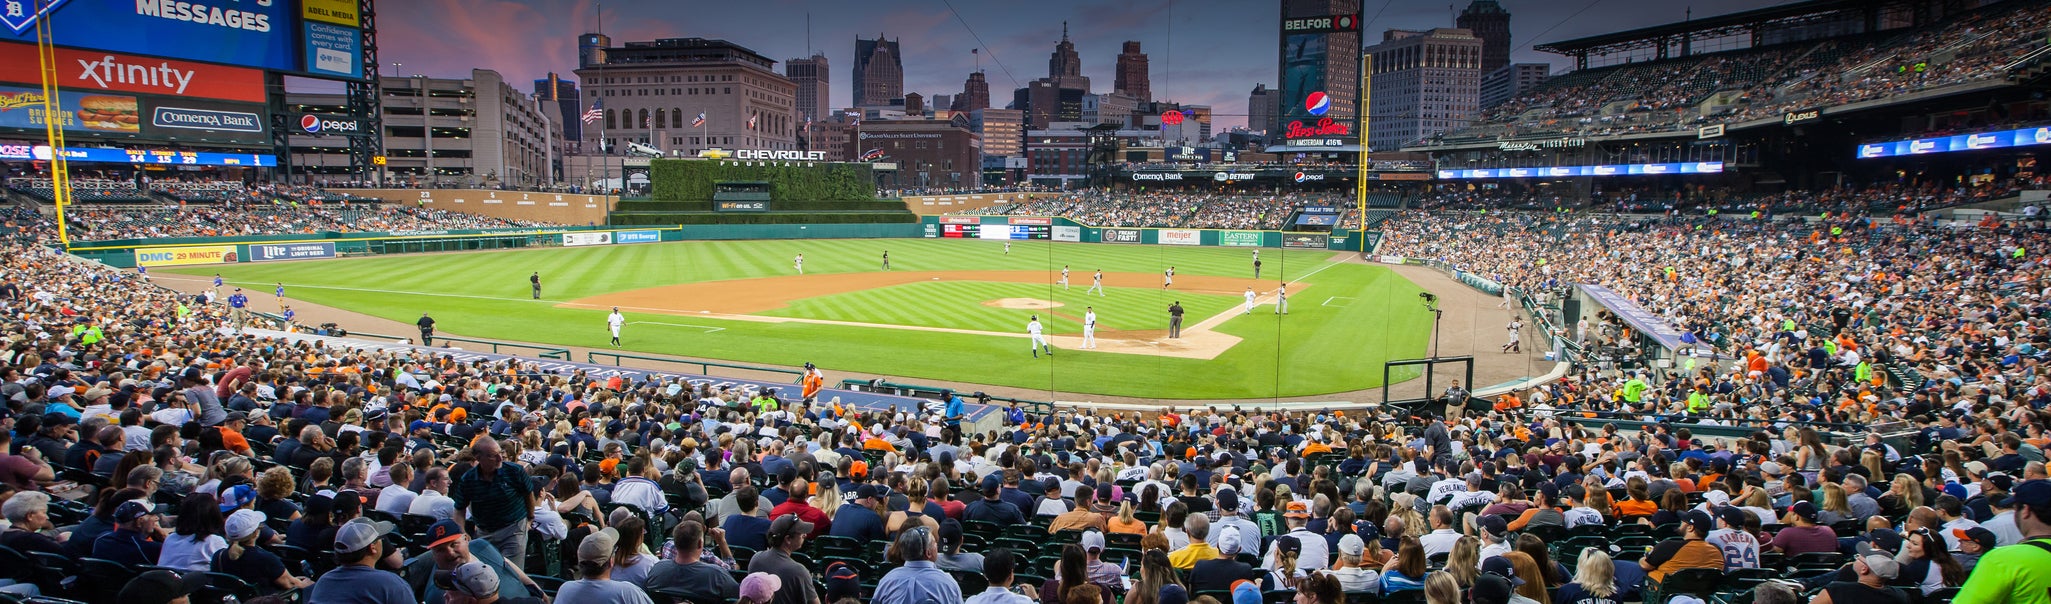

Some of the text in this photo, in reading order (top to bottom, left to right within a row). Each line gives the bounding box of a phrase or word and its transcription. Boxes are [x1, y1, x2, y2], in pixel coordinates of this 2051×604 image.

[137, 0, 271, 32] MESSAGES
[308, 6, 354, 20] ADELL MEDIA
[311, 24, 352, 36] Confidence
[1285, 18, 1331, 31] BELFOR
[311, 32, 353, 44] comes with
[312, 40, 333, 48] every
[78, 56, 195, 94] xfinity
[223, 115, 254, 126] Bank
[1793, 110, 1818, 121] LEXUS
[321, 120, 357, 132] pepsi
[737, 149, 826, 160] CHEVROLET
[1165, 172, 1183, 180] Bank
[1167, 231, 1192, 240] meijer
[1224, 231, 1258, 240] EASTERN
[140, 252, 174, 262] DMC
[189, 251, 222, 259] MINUTE
[263, 245, 286, 259] Lite
[1437, 484, 1467, 493] VERLANDE
[1724, 545, 1758, 571] 24
